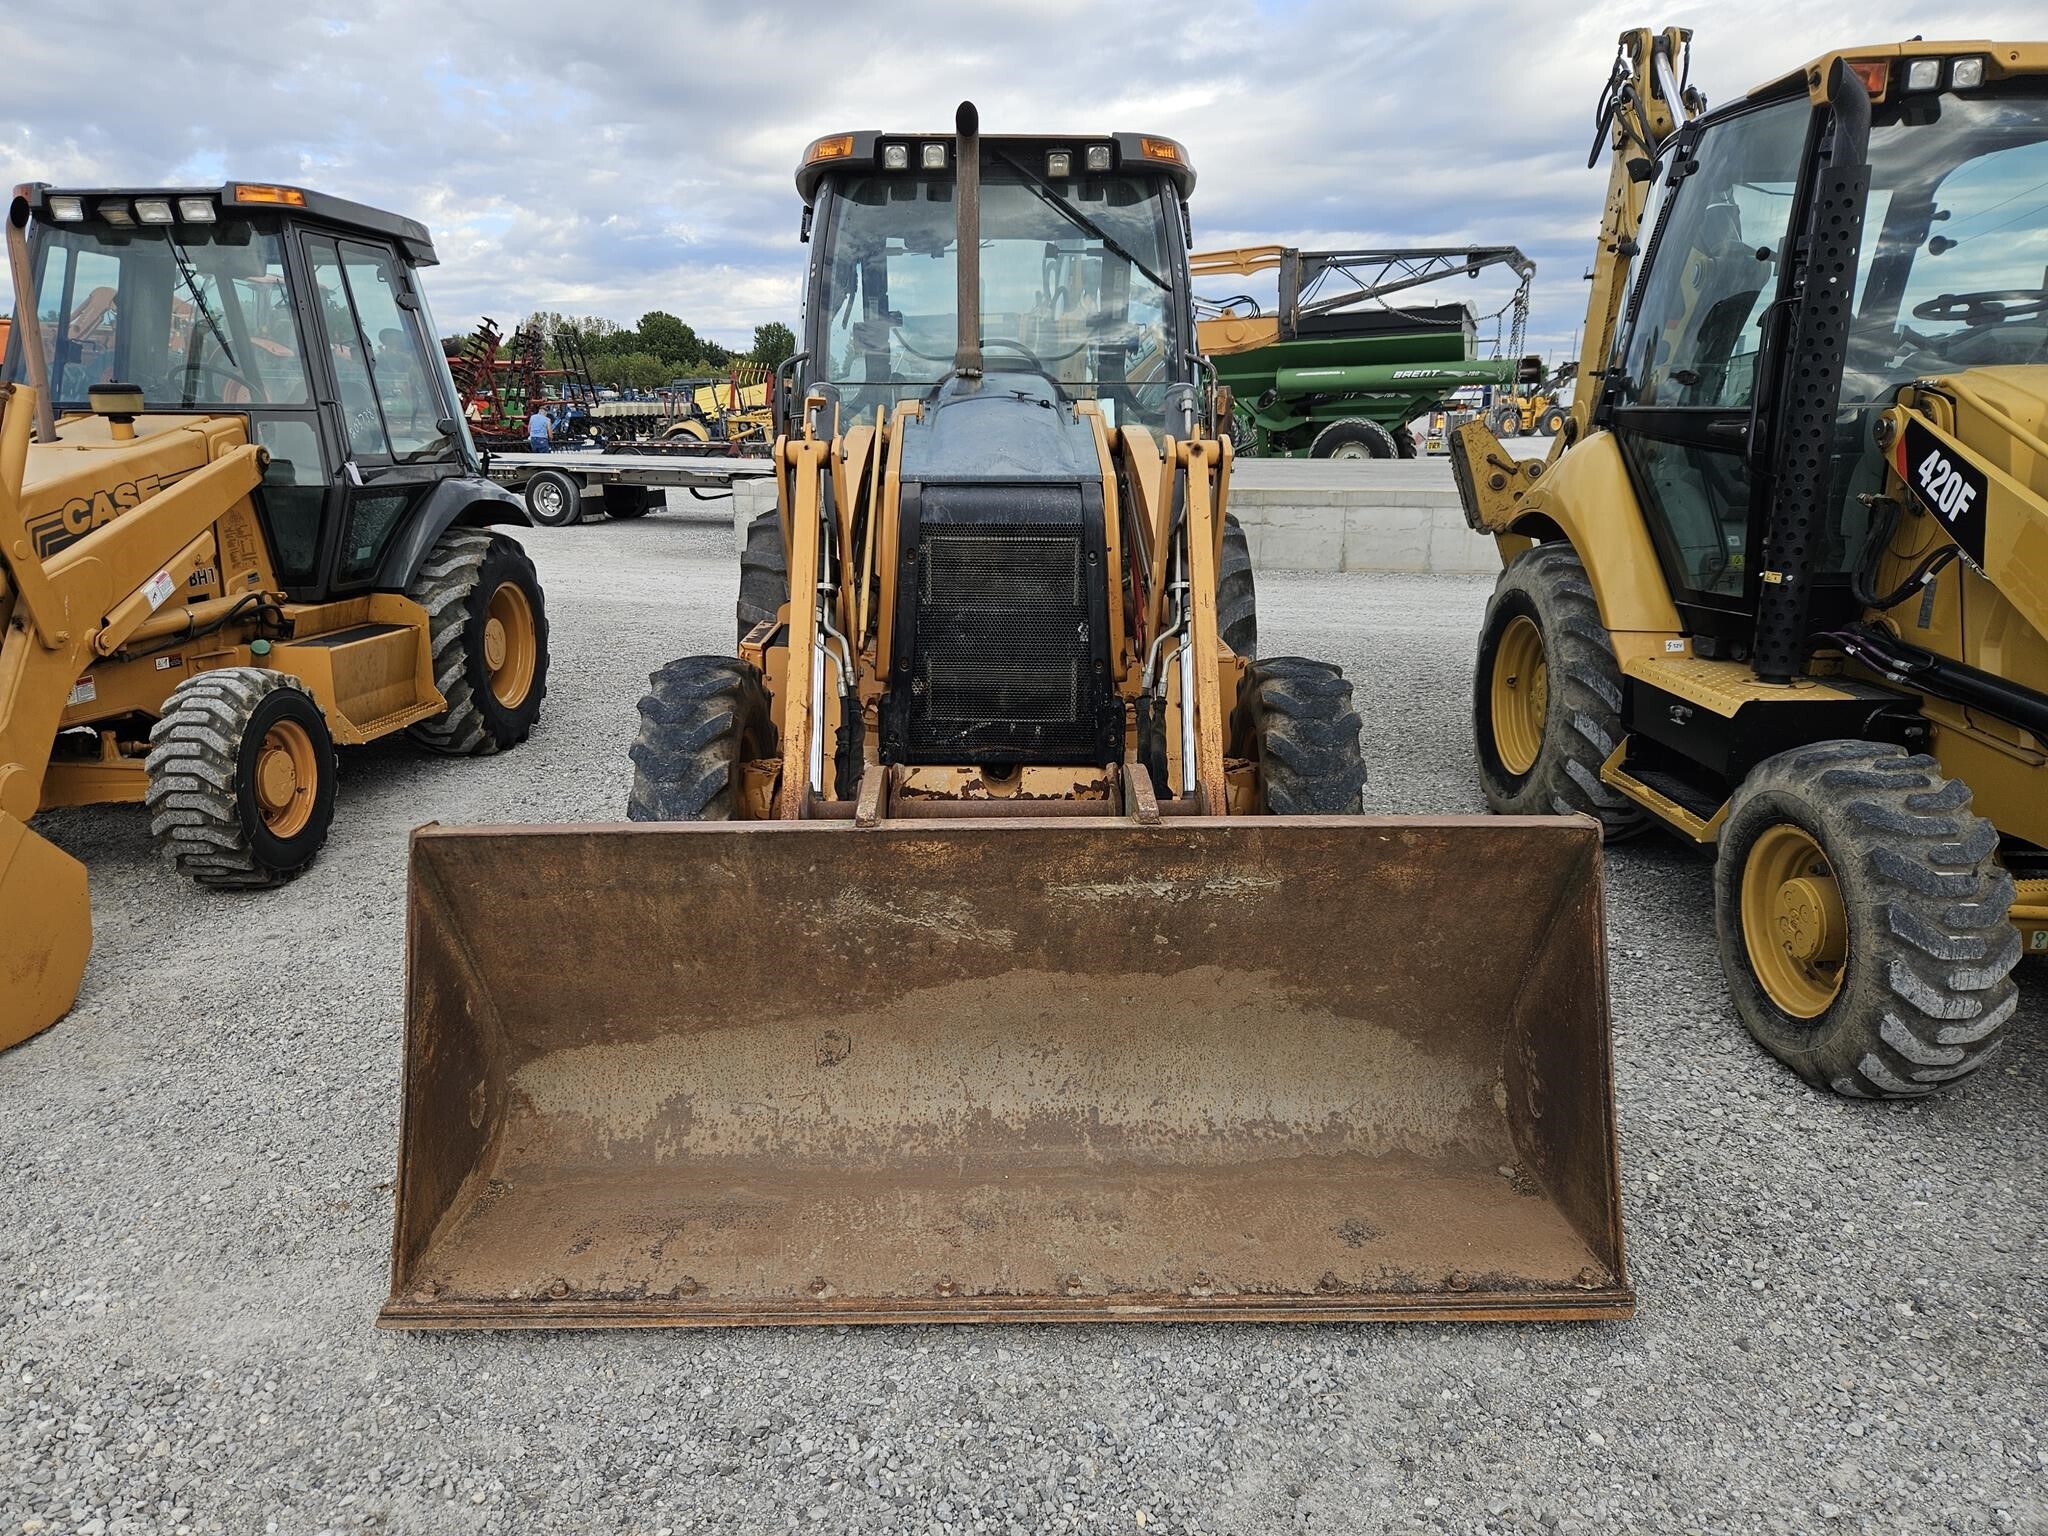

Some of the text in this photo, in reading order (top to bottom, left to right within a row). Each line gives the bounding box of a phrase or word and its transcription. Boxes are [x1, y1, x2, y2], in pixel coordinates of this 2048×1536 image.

[1392, 369, 1440, 379] BRENT
[62, 474, 160, 535] CASE
[1918, 449, 1977, 522] 420F
